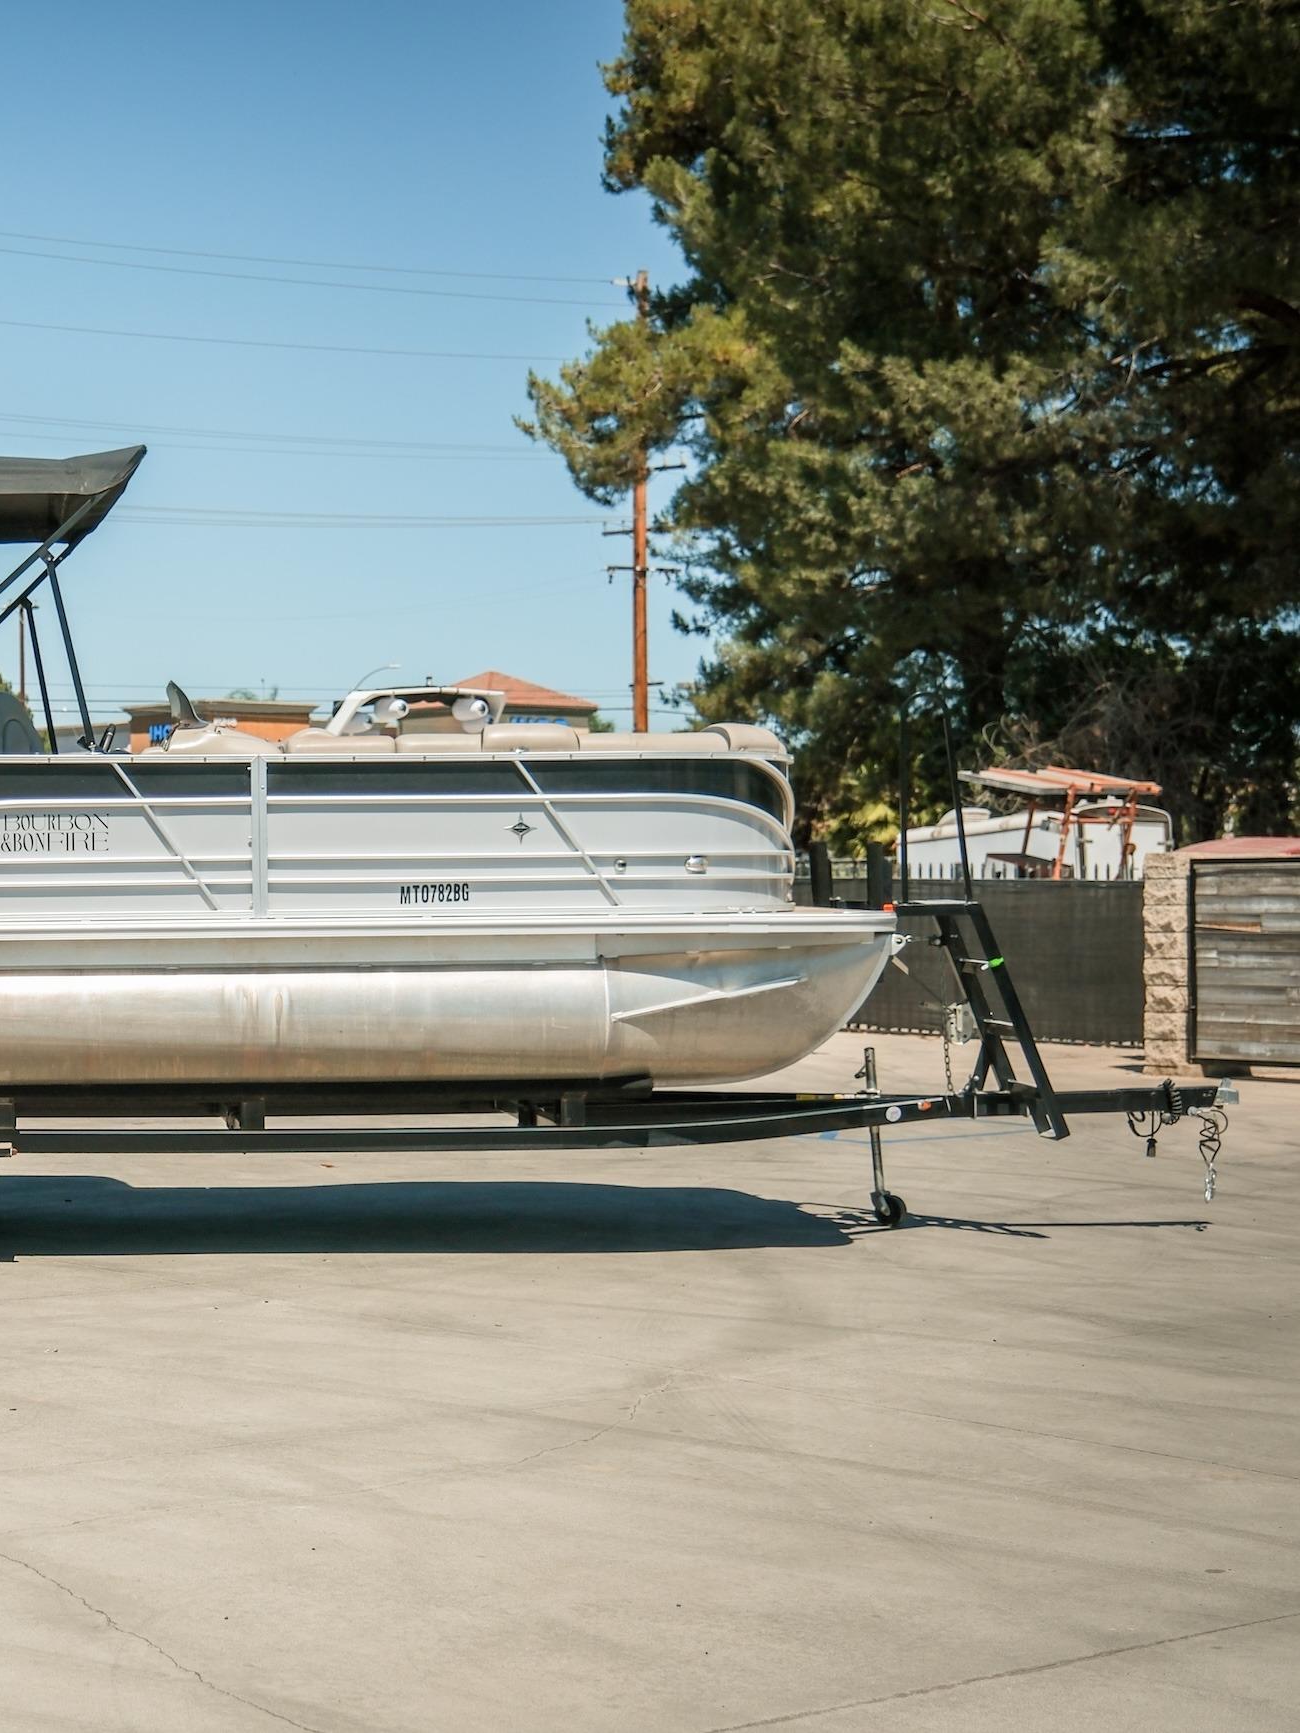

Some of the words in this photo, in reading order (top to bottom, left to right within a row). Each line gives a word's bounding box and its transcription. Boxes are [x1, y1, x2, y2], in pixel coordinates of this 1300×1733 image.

[3, 813, 110, 831] BOURBON
[0, 832, 109, 852] &BONFIRE
[400, 883, 469, 904] MT0782BG
